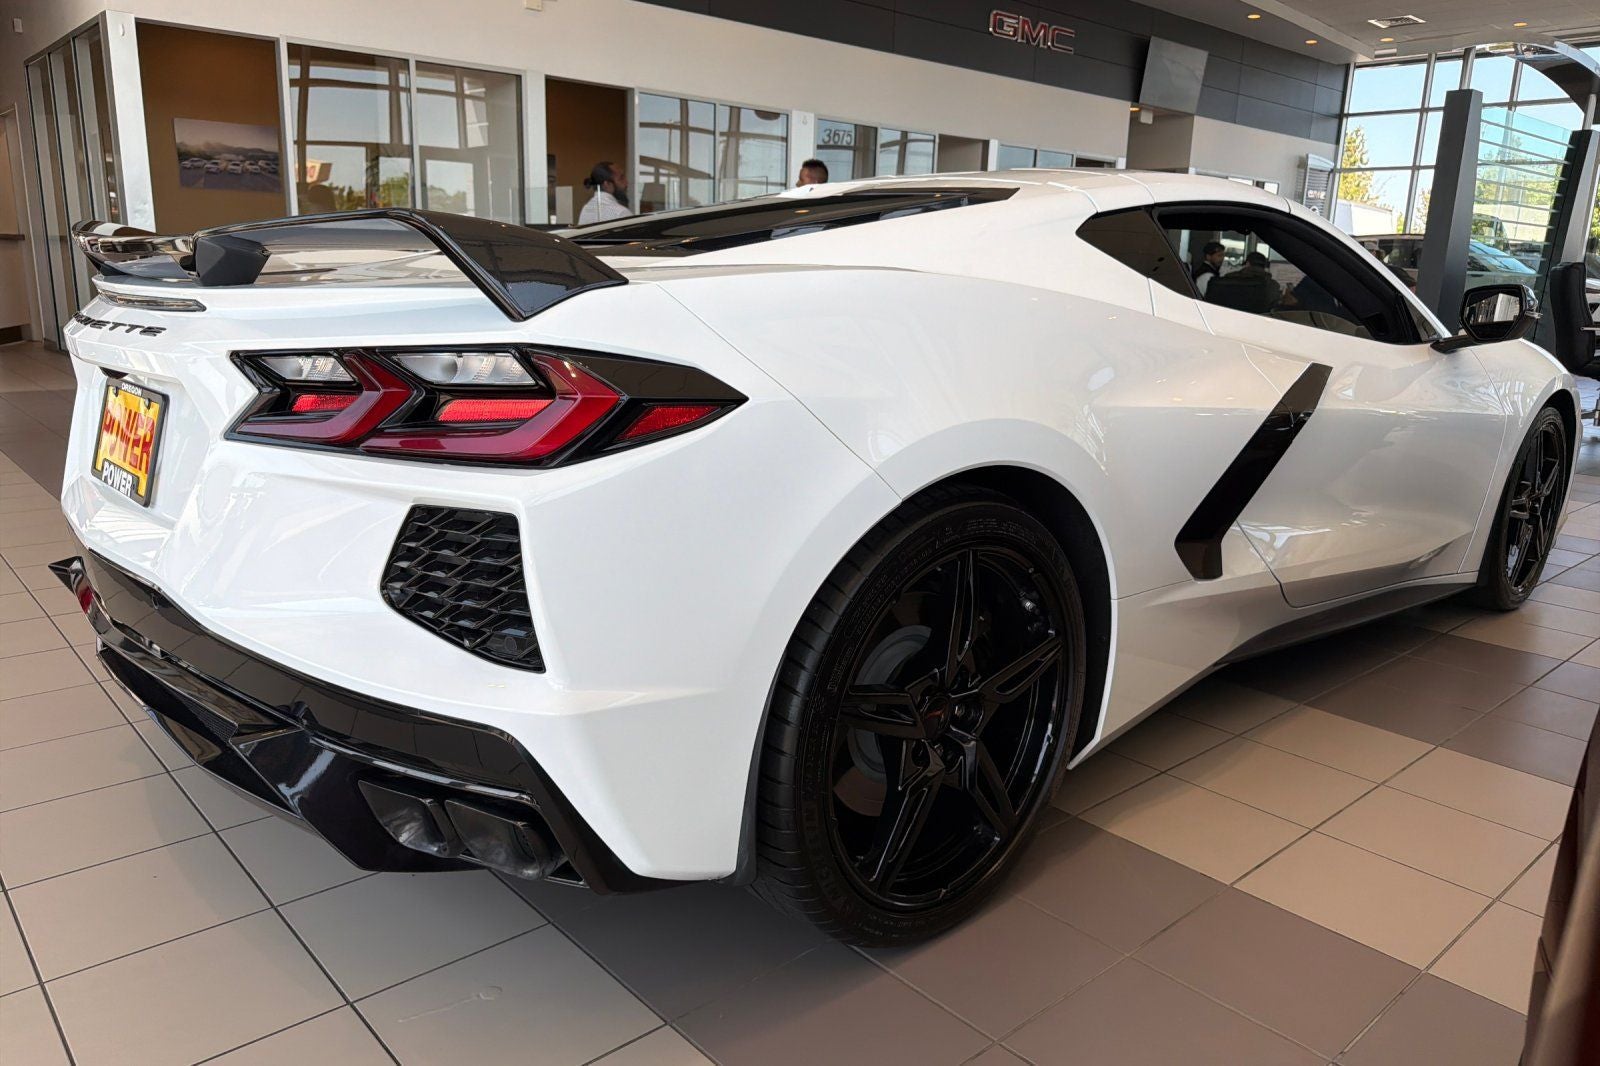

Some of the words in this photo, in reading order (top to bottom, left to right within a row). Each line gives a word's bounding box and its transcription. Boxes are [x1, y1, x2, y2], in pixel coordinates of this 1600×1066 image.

[989, 10, 1076, 54] GMC
[822, 128, 852, 145] 3675
[121, 382, 142, 397] OREGON
[102, 461, 133, 496] POWER
